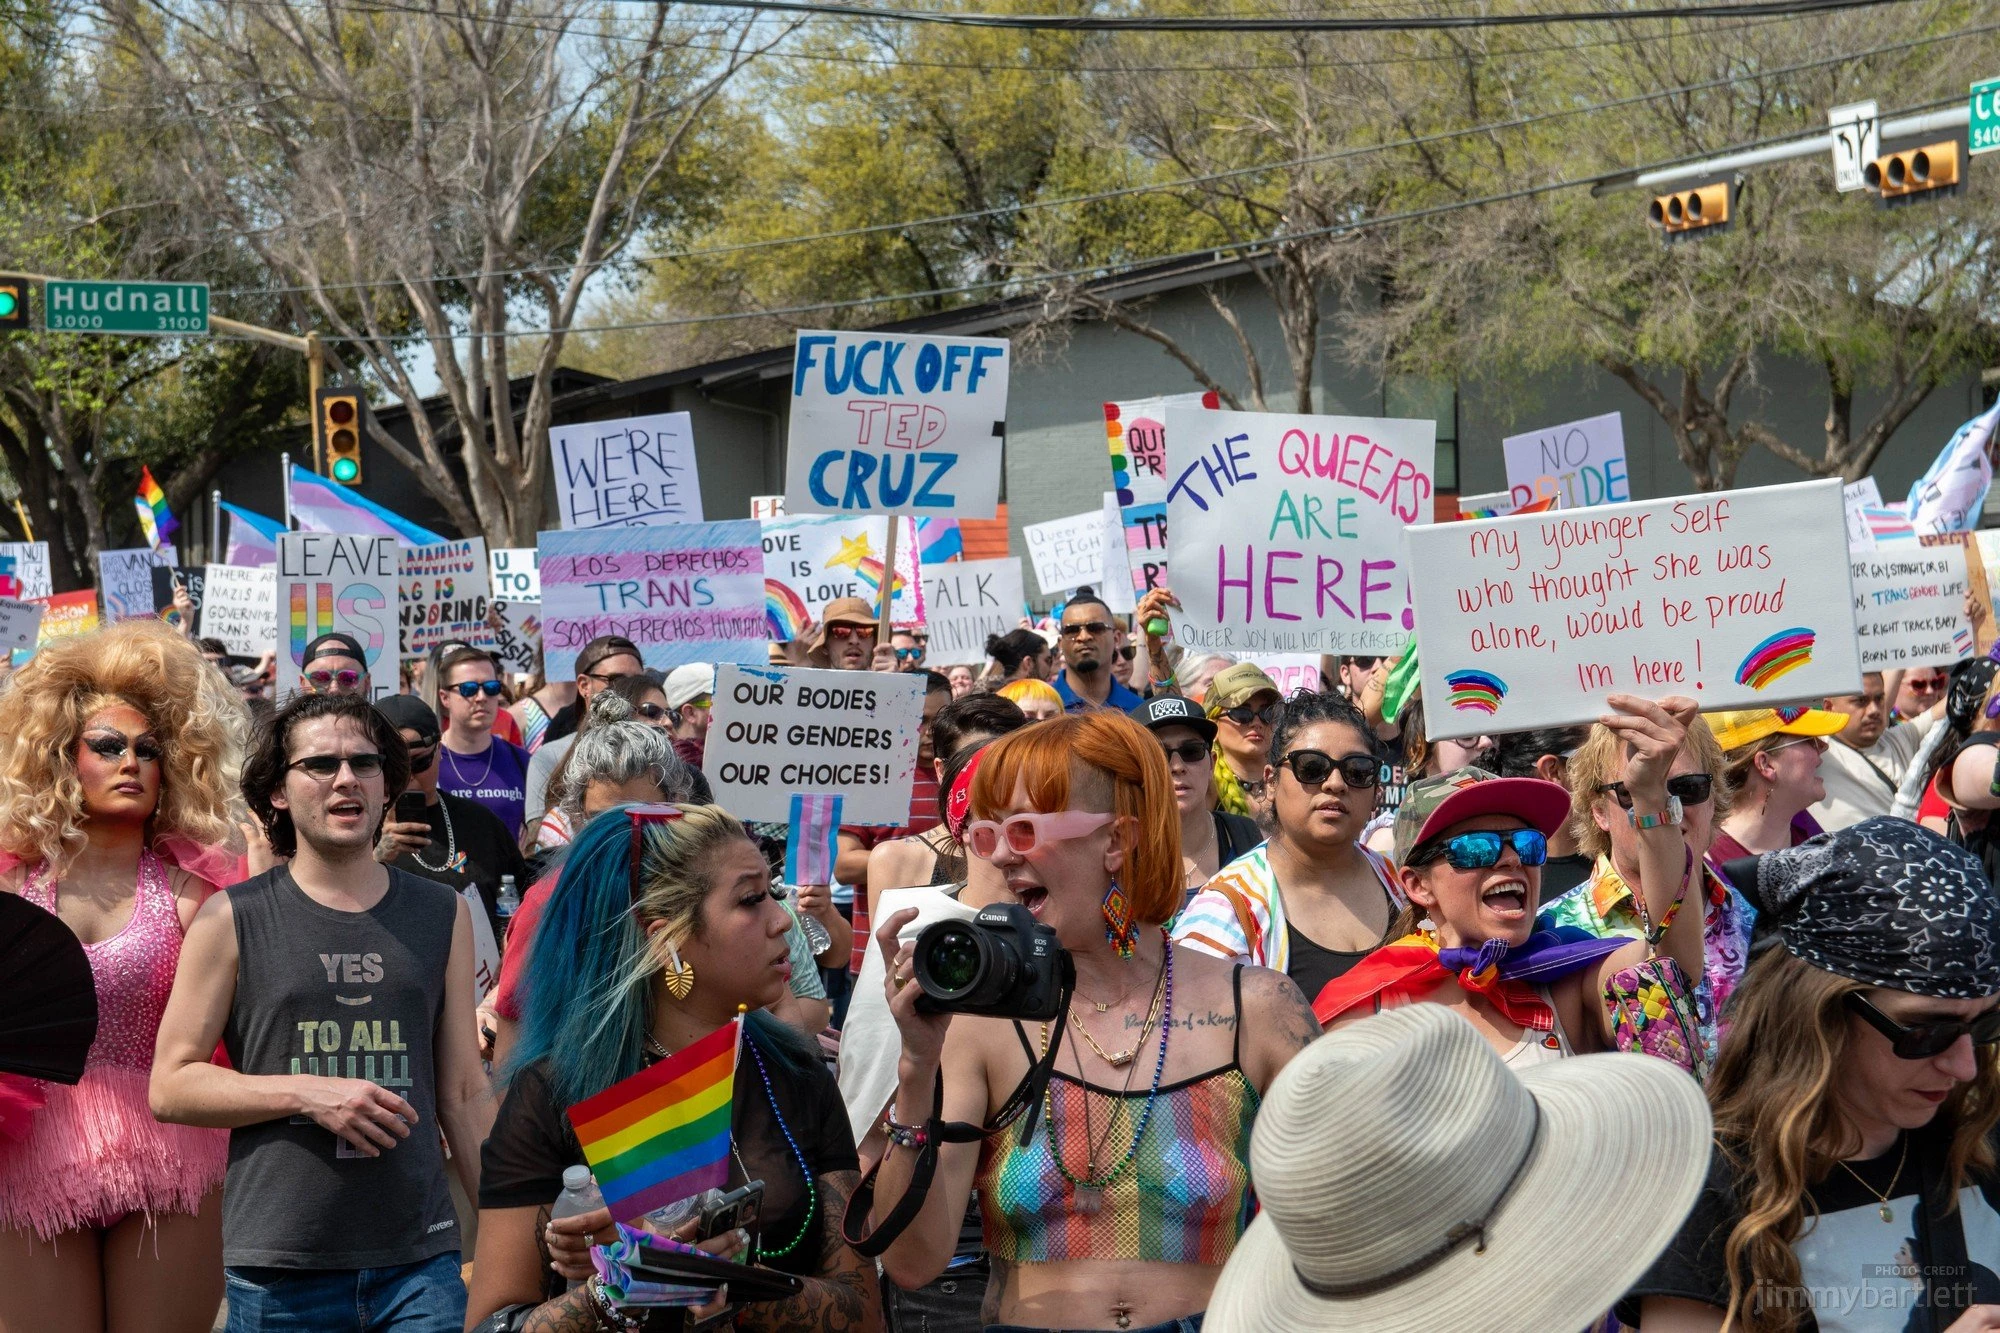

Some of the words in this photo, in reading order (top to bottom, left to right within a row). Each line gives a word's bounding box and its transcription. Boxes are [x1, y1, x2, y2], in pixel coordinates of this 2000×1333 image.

[53, 286, 200, 313] Hudnall
[53, 314, 103, 329] 3000
[157, 316, 202, 330] 3100
[795, 336, 906, 396] FUCK
[914, 343, 1004, 394] OFF
[847, 400, 947, 450] TED
[560, 427, 685, 490] WE'RE
[1540, 428, 1589, 474] NO
[808, 449, 959, 509] CRUZ
[1166, 432, 1258, 512] THE
[1278, 428, 1431, 524] QUEERS
[570, 482, 682, 525] HERE
[1268, 489, 1359, 541] ARE
[762, 534, 801, 554] OVE
[1469, 528, 1521, 571] my
[1541, 513, 1651, 571] younger
[281, 537, 395, 577] LEAVE
[573, 555, 621, 577] LOS
[645, 551, 750, 573] DERECHOS
[791, 560, 812, 578] IS
[211, 567, 253, 582] THERE
[434, 577, 455, 601] IS
[496, 573, 530, 593] TO
[1217, 544, 1415, 632] HERE!
[1457, 577, 1513, 614] who
[1529, 557, 1640, 607] thought
[1653, 551, 1703, 582] she
[1717, 543, 1772, 573] was
[1943, 581, 1964, 597] LIFE
[211, 585, 253, 601] NAZIS
[257, 590, 271, 602] IN
[584, 577, 715, 612] TRANS
[806, 582, 858, 603] LOVE
[290, 582, 387, 668] US
[399, 595, 487, 626] NSORING
[1470, 616, 1557, 653] alone,
[1566, 600, 1644, 640] would
[1663, 592, 1698, 628] be
[1705, 577, 1787, 629] proud
[208, 622, 251, 636] TRANS
[260, 626, 278, 640] KID
[553, 619, 597, 648] SON
[610, 615, 705, 643] DERECHOS
[1181, 624, 1236, 647] QUEER
[1242, 628, 1268, 648] JOY
[1272, 631, 1297, 649] WILL
[1301, 627, 1330, 651] NOT
[1330, 630, 1346, 649] BE
[1872, 620, 1900, 637] RIGHT
[1935, 615, 1957, 631] BABY
[1862, 649, 1888, 664] BORN
[1890, 648, 1907, 660] TO
[1911, 641, 1952, 657] SURVIVE
[733, 683, 785, 706] OUR
[797, 686, 877, 711] BODIES
[726, 721, 779, 745] OUR
[787, 725, 893, 751] GENDERS
[719, 762, 771, 786] OUR
[780, 763, 890, 786] CHOICES!
[450, 788, 473, 798] are
[979, 912, 1008, 922] Canon
[1034, 938, 1047, 946] EOS
[319, 952, 384, 983] YES
[297, 1020, 341, 1053] TO
[349, 1019, 408, 1052] ALL
